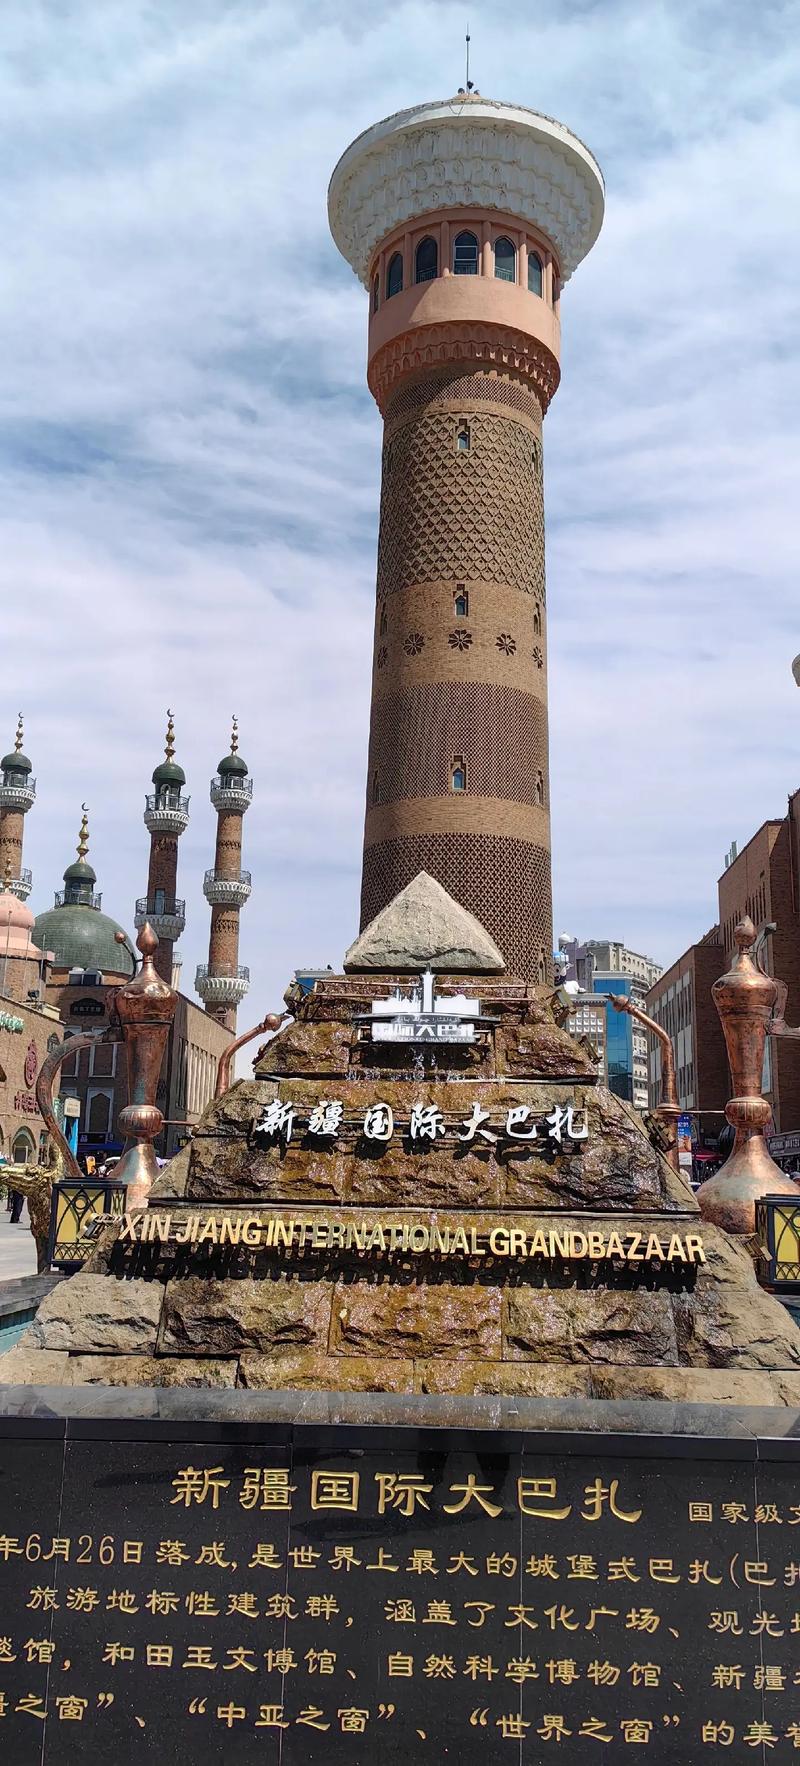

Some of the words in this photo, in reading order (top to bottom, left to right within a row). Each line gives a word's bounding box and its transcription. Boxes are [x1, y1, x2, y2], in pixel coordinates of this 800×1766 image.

[255, 1099, 589, 1143] 新疆国际大巴扎
[118, 1213, 174, 1243] XIN
[175, 1216, 263, 1246] JIANG
[265, 1220, 486, 1255] INTERNATIONAL
[169, 1466, 643, 1524] 新疆国际大巴扎
[25, 1586, 800, 1639] 旅游地标性建筑群，涵盖了文化广场、观光
[0, 1636, 800, 1697] 馆，和田玉文博馆、自然科学博物馆、新疆
[0, 1691, 800, 1749] 之窗”、“中亚之窗”、“世界之窗”的美
